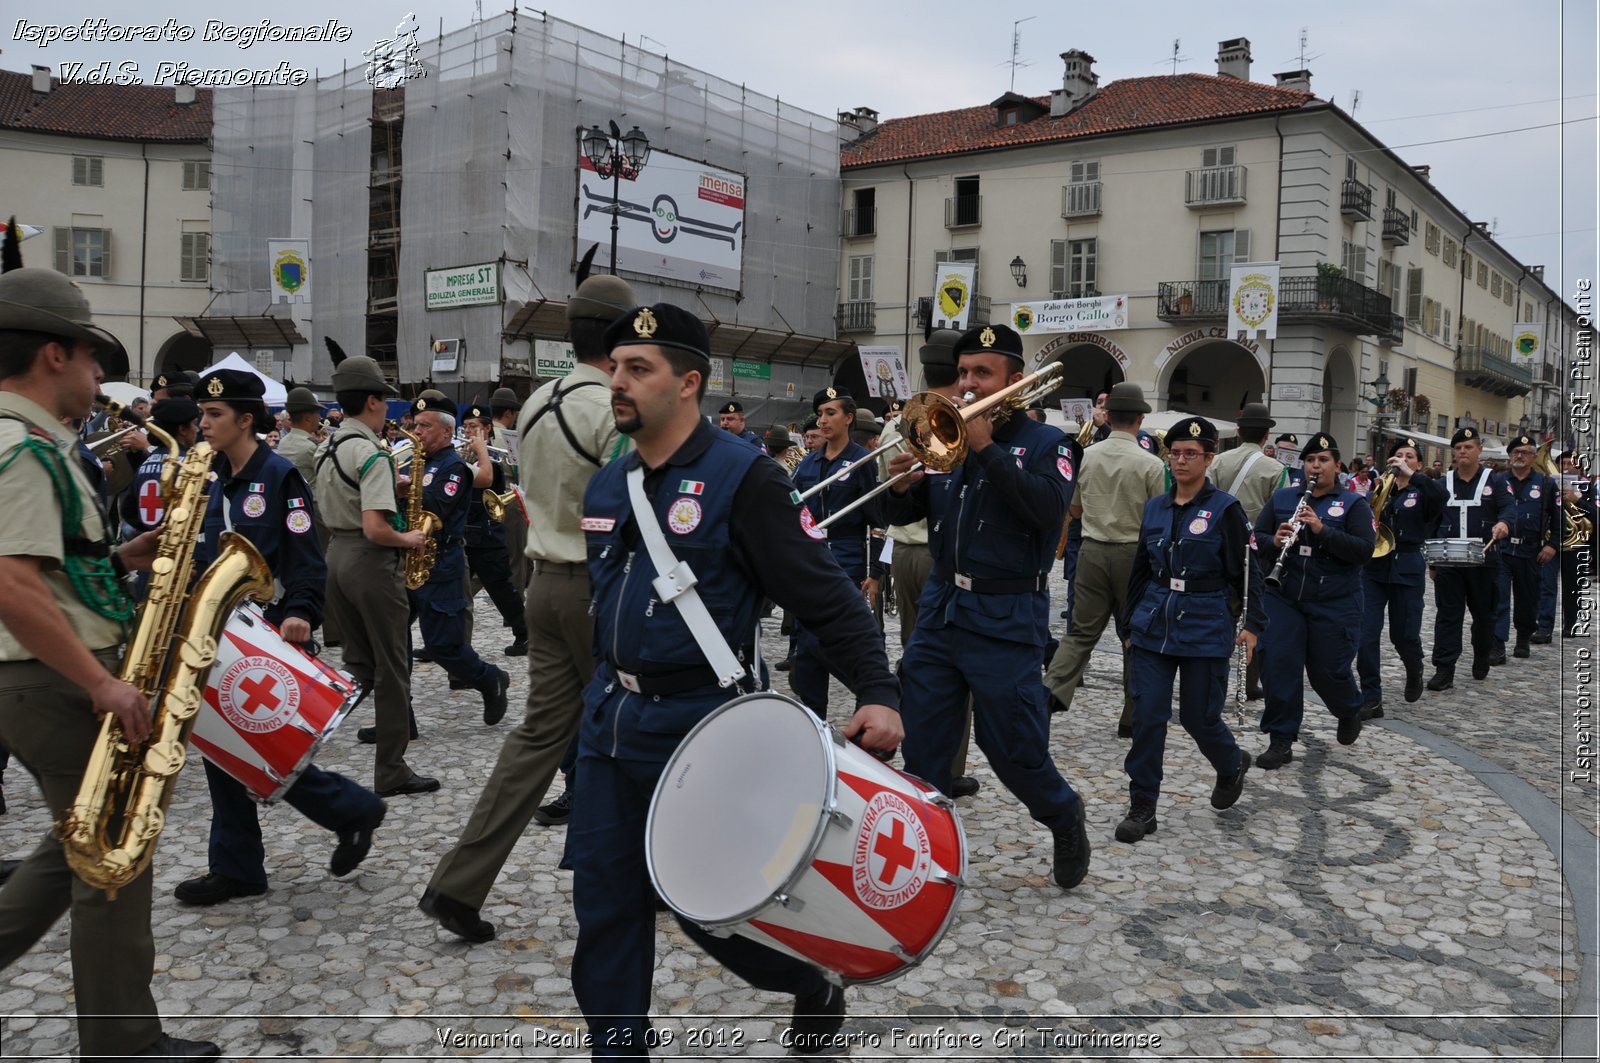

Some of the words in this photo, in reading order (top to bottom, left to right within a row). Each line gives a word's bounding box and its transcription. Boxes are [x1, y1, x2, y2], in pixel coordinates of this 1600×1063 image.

[702, 176, 743, 197] mensa
[446, 273, 475, 288] IMPRESA
[477, 267, 492, 284] ST
[428, 290, 456, 300] EDILIZIA
[457, 286, 495, 298] GENERALE
[1043, 302, 1061, 311] Palio
[1063, 301, 1075, 310] dei
[1076, 299, 1102, 310] Borghi
[1037, 313, 1073, 325] Borgo
[1076, 309, 1110, 321] Gallo
[1067, 332, 1128, 365] RISTORANTE
[1166, 329, 1206, 355] NUOVA
[1209, 327, 1260, 354] CEAIA
[537, 359, 575, 370] EDILIZIA
[252, 658, 263, 667] 22
[264, 659, 295, 686] AGOSTO
[221, 659, 252, 692] GINEVRA
[221, 694, 231, 703] DI
[287, 688, 298, 708] 1864
[223, 703, 283, 732] CONVENZIONE
[874, 796, 885, 812] 22
[885, 794, 917, 825] AGOSTO
[855, 807, 878, 866] GINEVRA
[915, 825, 929, 854] 1864
[855, 868, 867, 881] DI
[857, 876, 922, 908] CONVENZIONE
